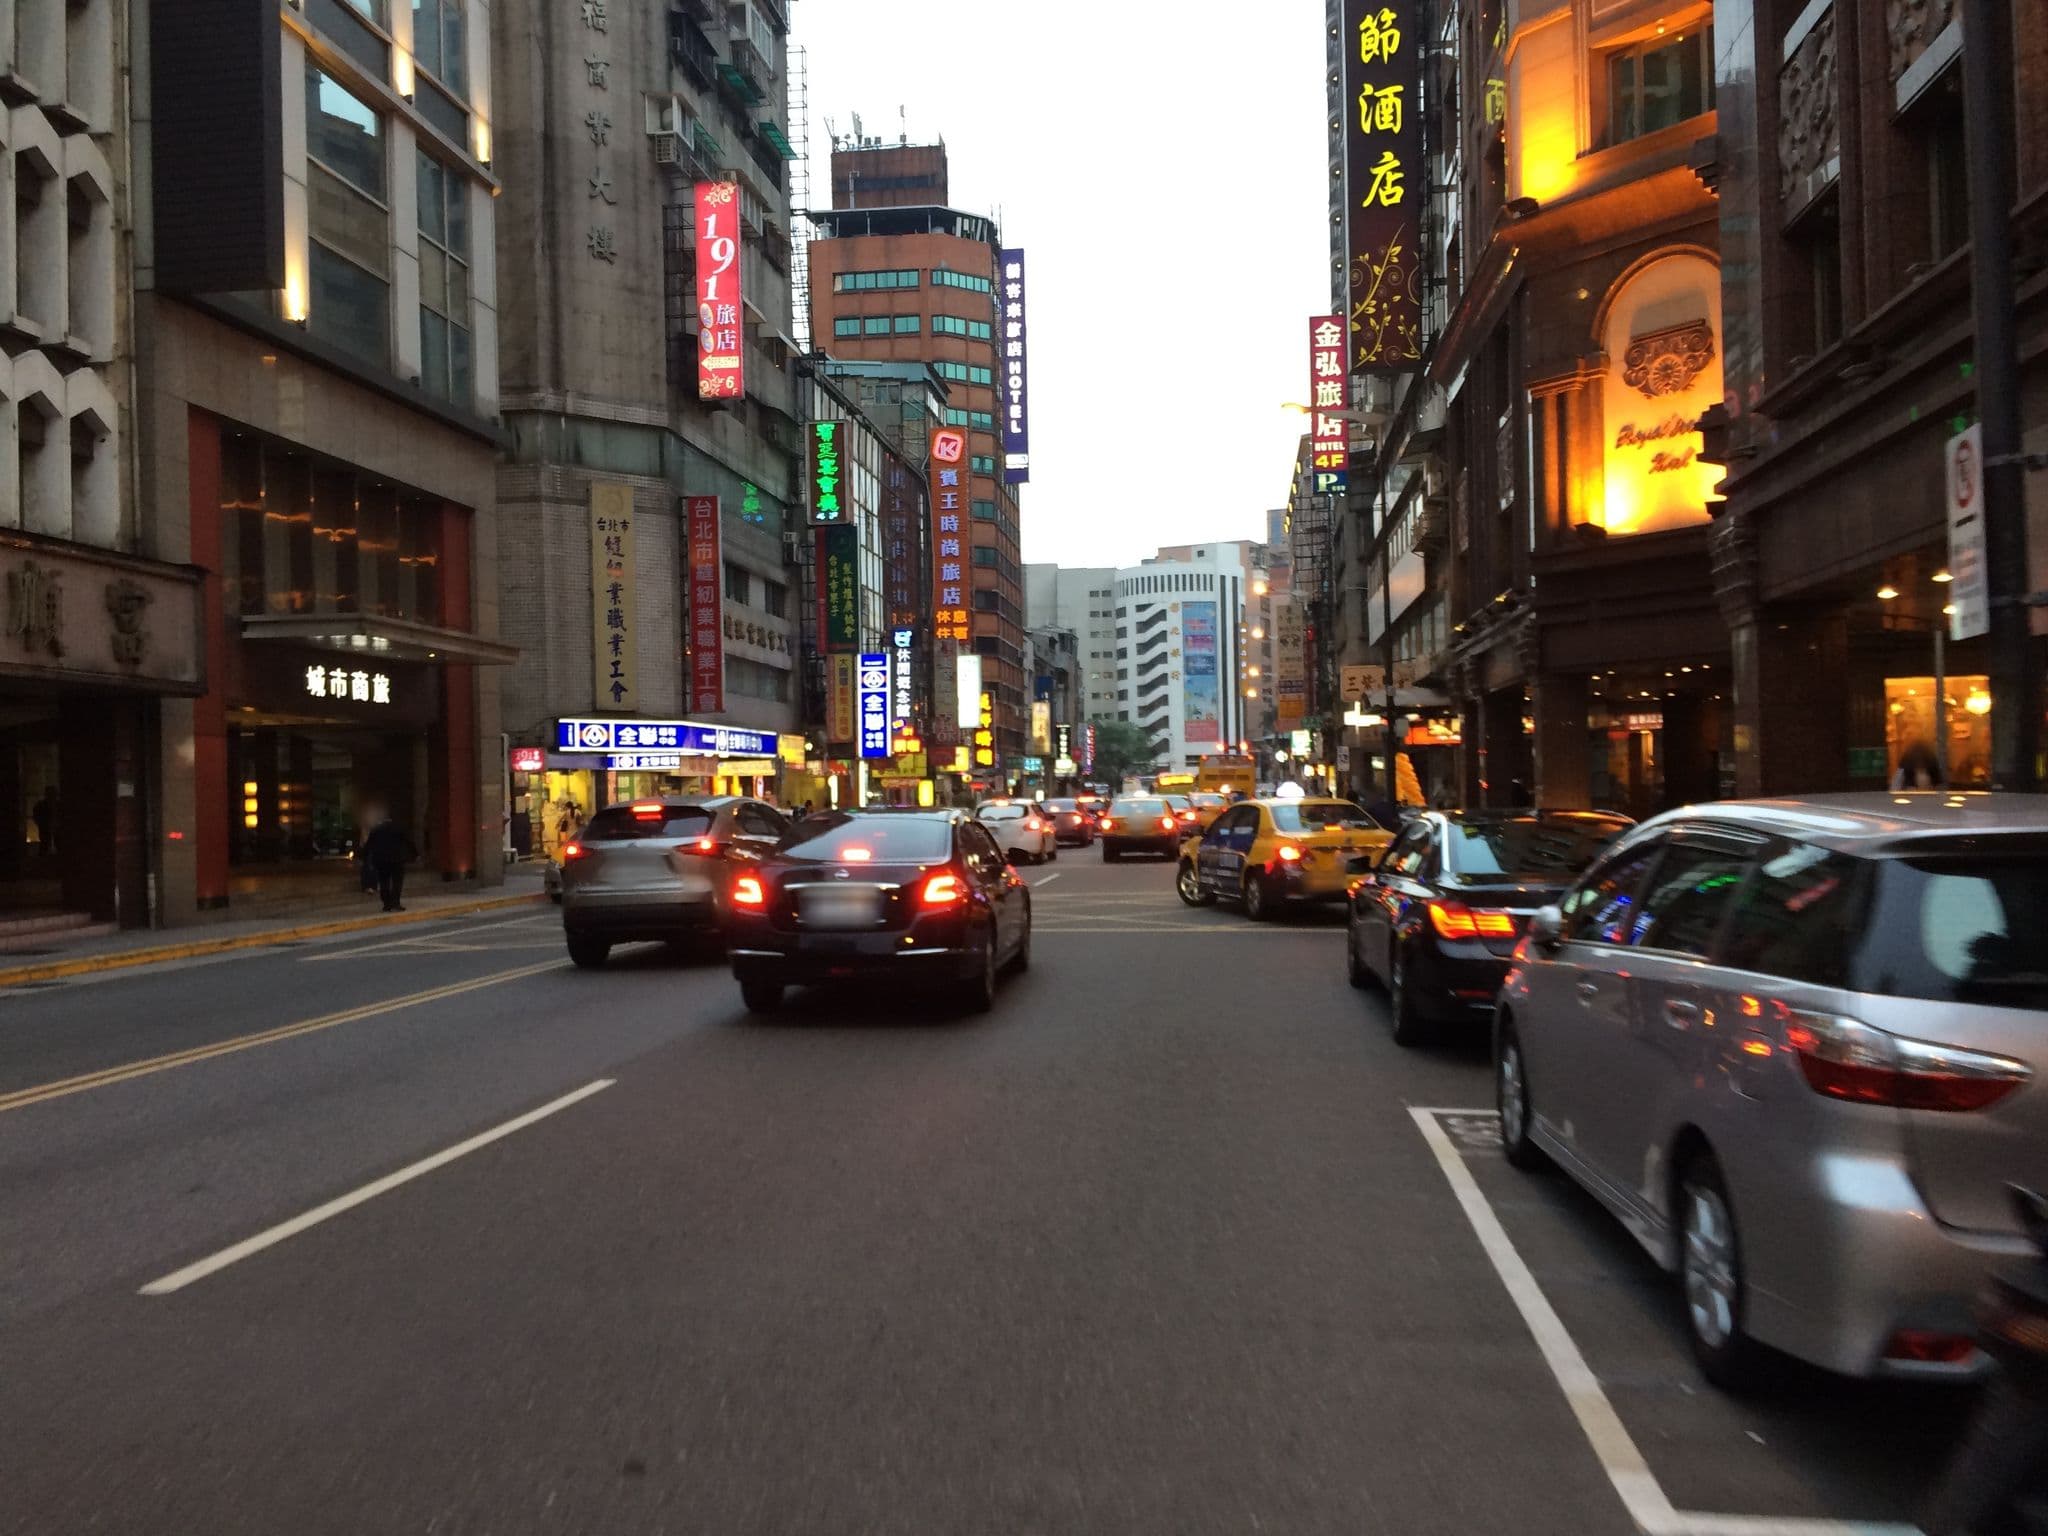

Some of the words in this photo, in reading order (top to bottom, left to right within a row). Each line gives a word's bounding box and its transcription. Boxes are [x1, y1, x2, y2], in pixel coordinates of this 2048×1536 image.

[1358, 8, 1405, 208] 節酒店
[702, 213, 736, 301] 191
[716, 304, 736, 351] 旅店
[1008, 361, 1023, 434] HOTEL
[1314, 321, 1343, 437] 金弘旅店
[1314, 441, 1346, 452] HOTEL
[1315, 453, 1344, 468] 4F
[935, 610, 968, 625] 休息
[305, 664, 391, 704] 城市商旅
[863, 694, 885, 731] 全聯
[618, 726, 658, 746] 全聯
